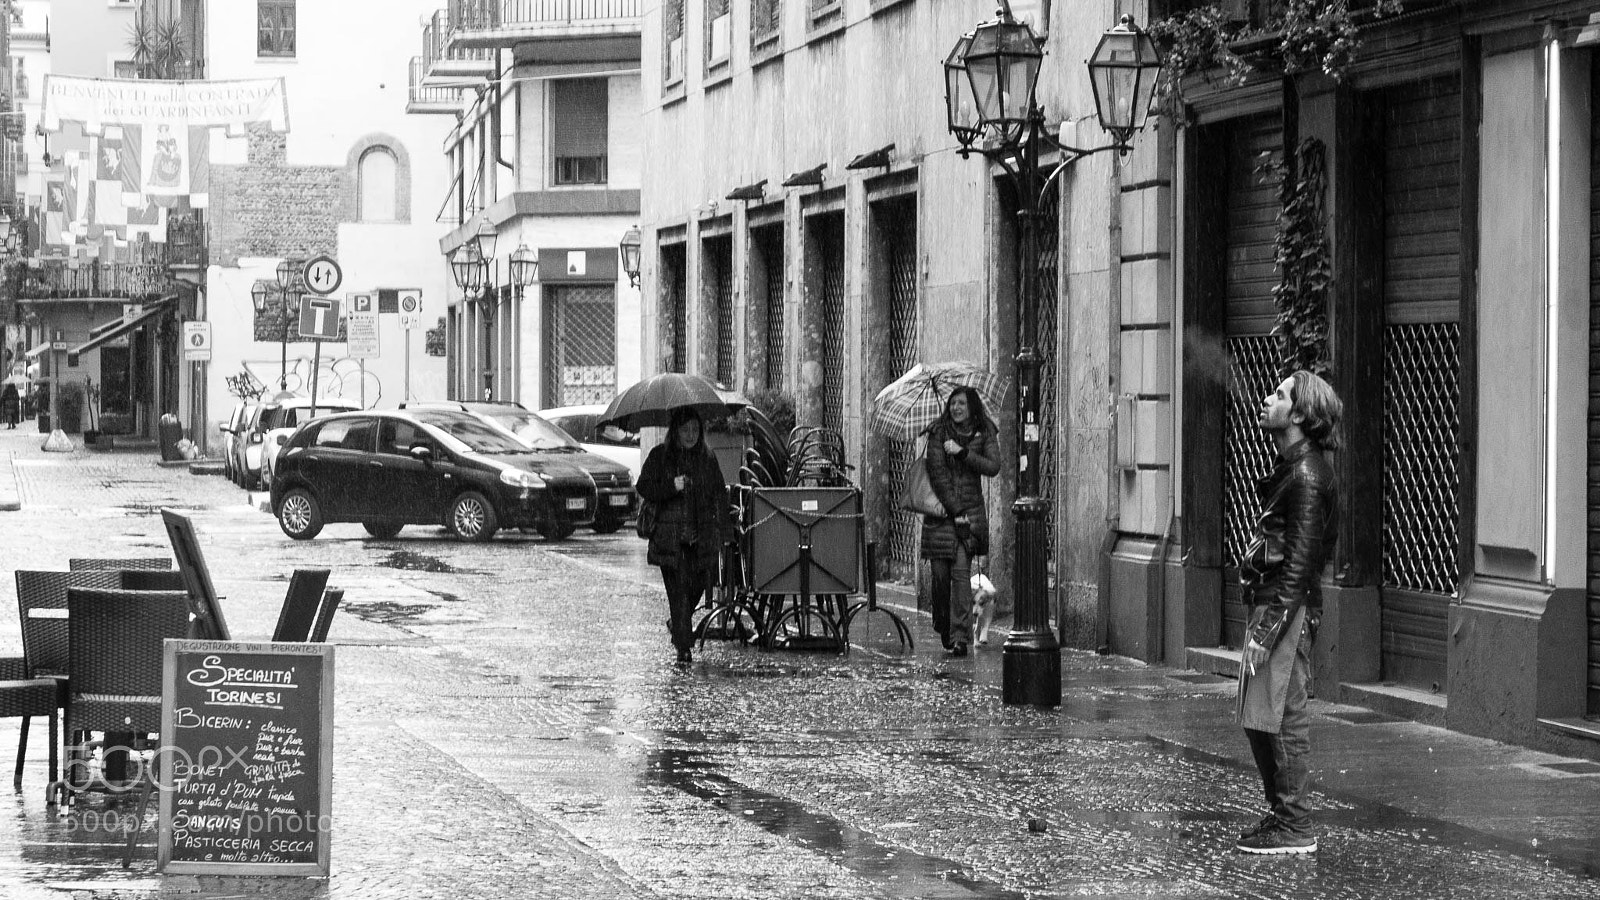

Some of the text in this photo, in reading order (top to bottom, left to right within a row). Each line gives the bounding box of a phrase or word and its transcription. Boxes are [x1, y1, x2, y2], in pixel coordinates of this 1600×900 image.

[51, 84, 147, 102] BENVENUTI
[187, 86, 277, 103] CONTRADA
[104, 101, 124, 116] dei
[358, 296, 368, 311] P
[176, 640, 322, 654] DEGUSTAZIONE VINI PIEMONTESI
[206, 688, 281, 704] TORINESI
[173, 759, 227, 777] BONET
[244, 760, 291, 779] GRANITA
[173, 778, 216, 795] TURTA
[198, 796, 223, 810] gelato
[173, 809, 241, 831] SANGUIS
[173, 829, 314, 853] PASTICCERIA SECCA
[204, 853, 213, 861] e
[220, 851, 248, 862] molto
